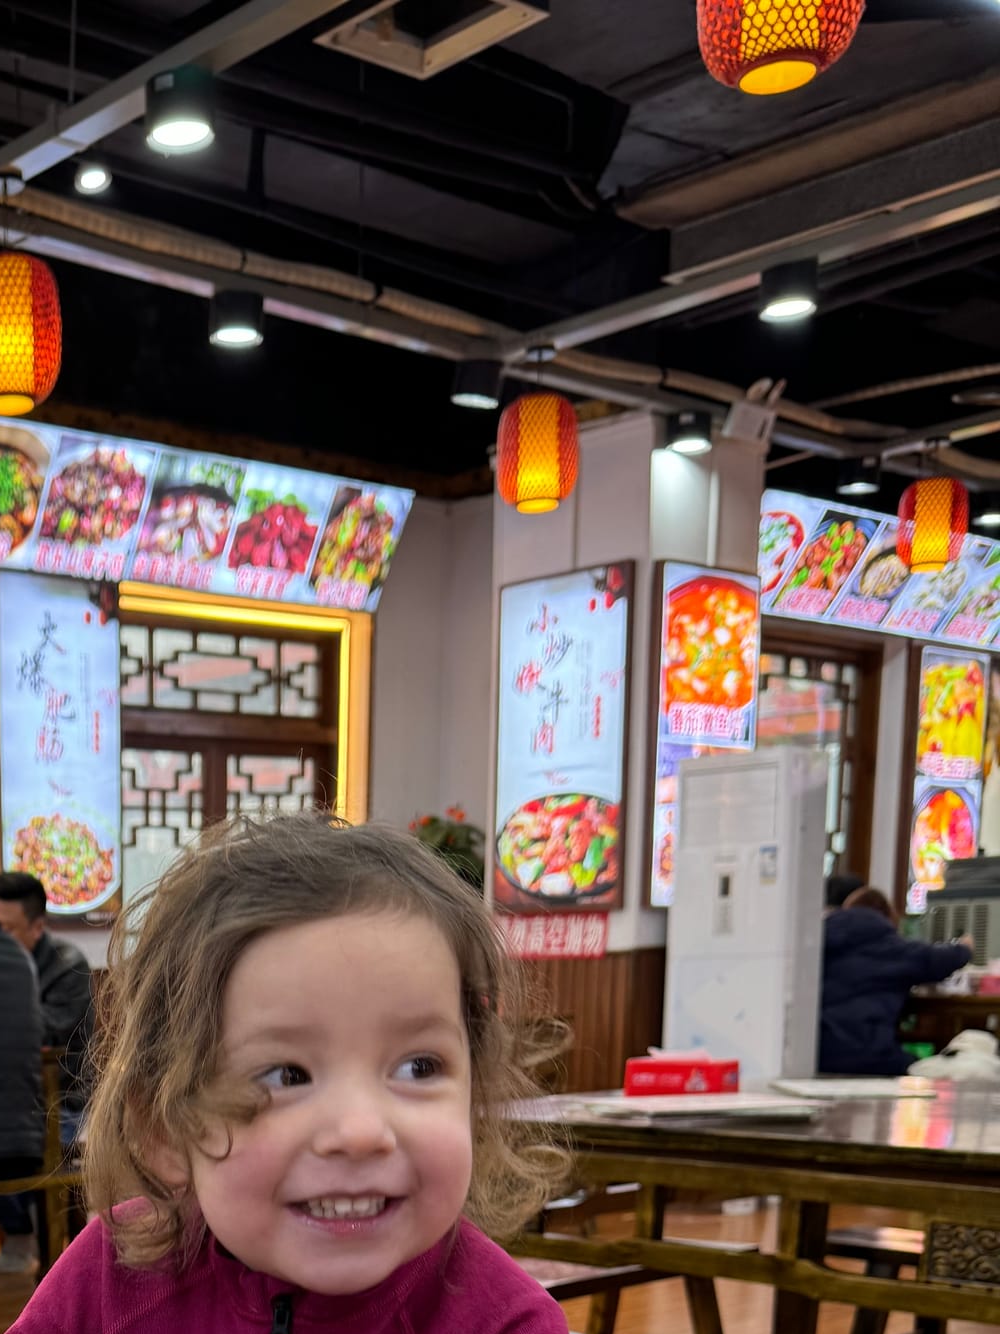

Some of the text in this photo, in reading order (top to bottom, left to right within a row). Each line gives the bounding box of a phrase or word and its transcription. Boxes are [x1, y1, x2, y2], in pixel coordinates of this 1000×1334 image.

[493, 913, 606, 956] 勿高空抛物
